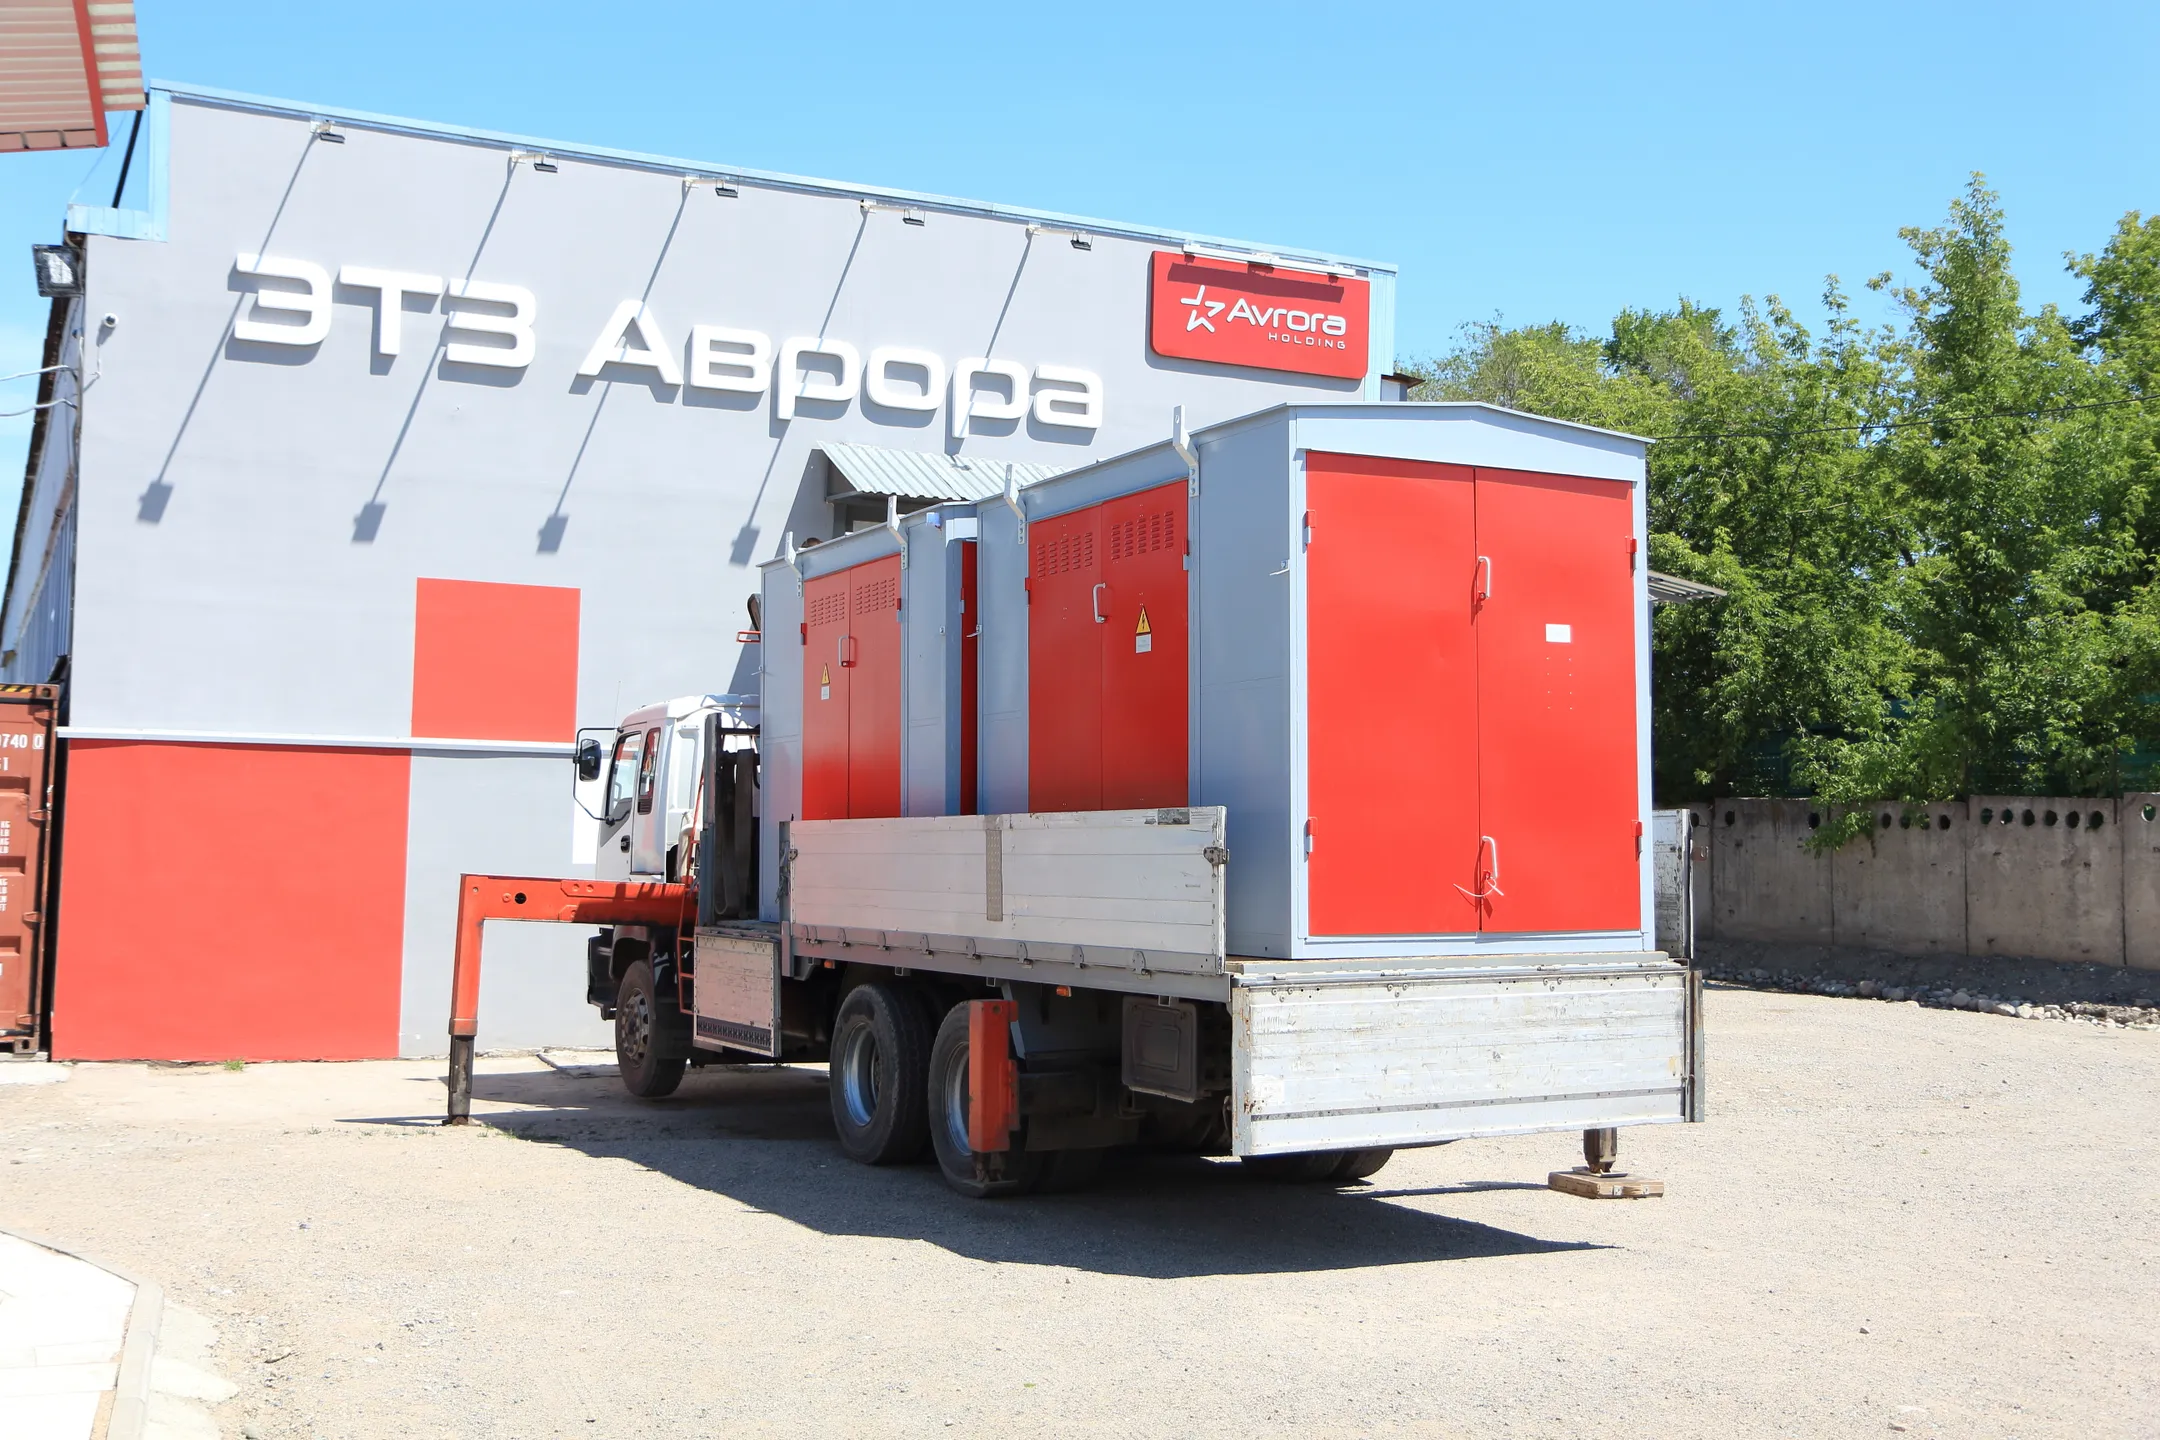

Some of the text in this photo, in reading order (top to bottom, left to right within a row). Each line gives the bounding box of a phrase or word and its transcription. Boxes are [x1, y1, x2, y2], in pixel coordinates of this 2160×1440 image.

[1226, 298, 1347, 336] Avrora
[235, 253, 1104, 438] ЭТЗ Аврора
[1268, 332, 1346, 350] HOLDING
[0, 733, 28, 748] 740
